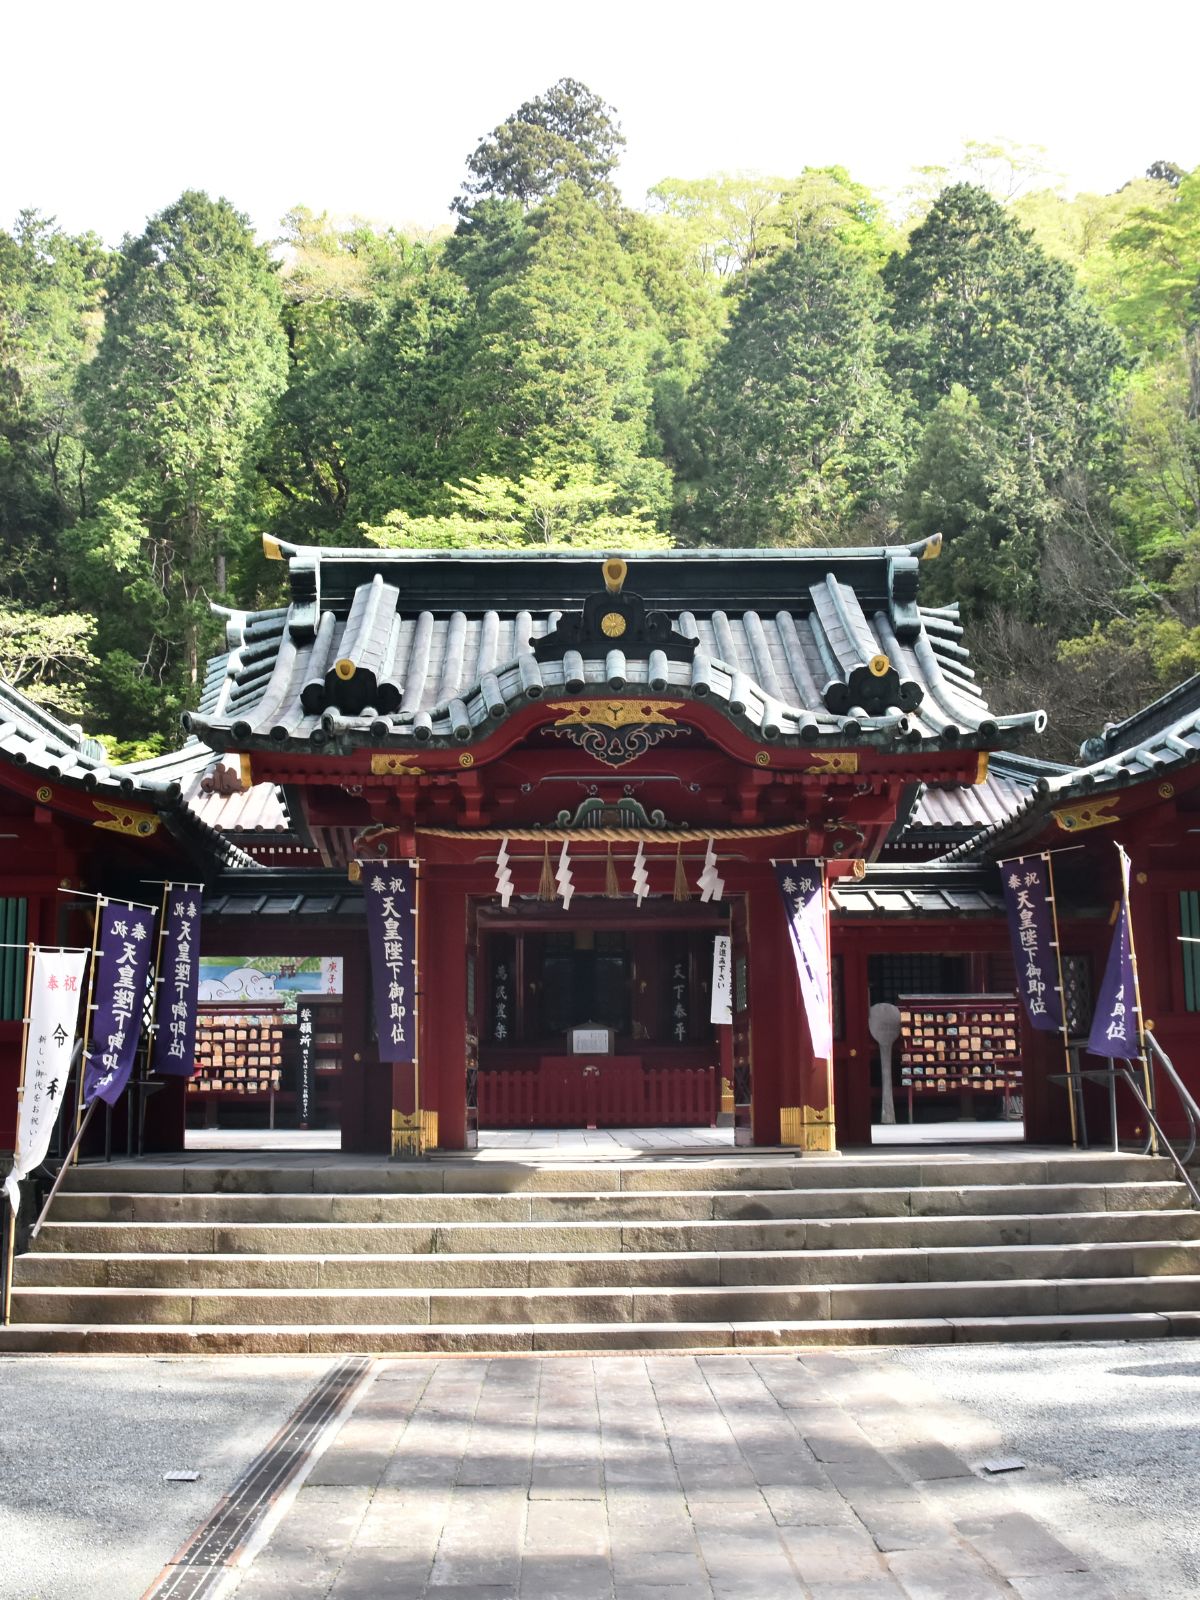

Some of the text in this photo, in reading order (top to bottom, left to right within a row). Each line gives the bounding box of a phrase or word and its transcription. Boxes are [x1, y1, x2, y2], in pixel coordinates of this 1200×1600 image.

[370, 875, 406, 894] 奉祝
[782, 876, 816, 895] 奉祝
[1008, 872, 1040, 889] 奉祝
[1017, 889, 1047, 1016] 天皇陛下御即位
[381, 896, 406, 1045] 天皇陛下御即位
[48, 975, 77, 992] 奉祝
